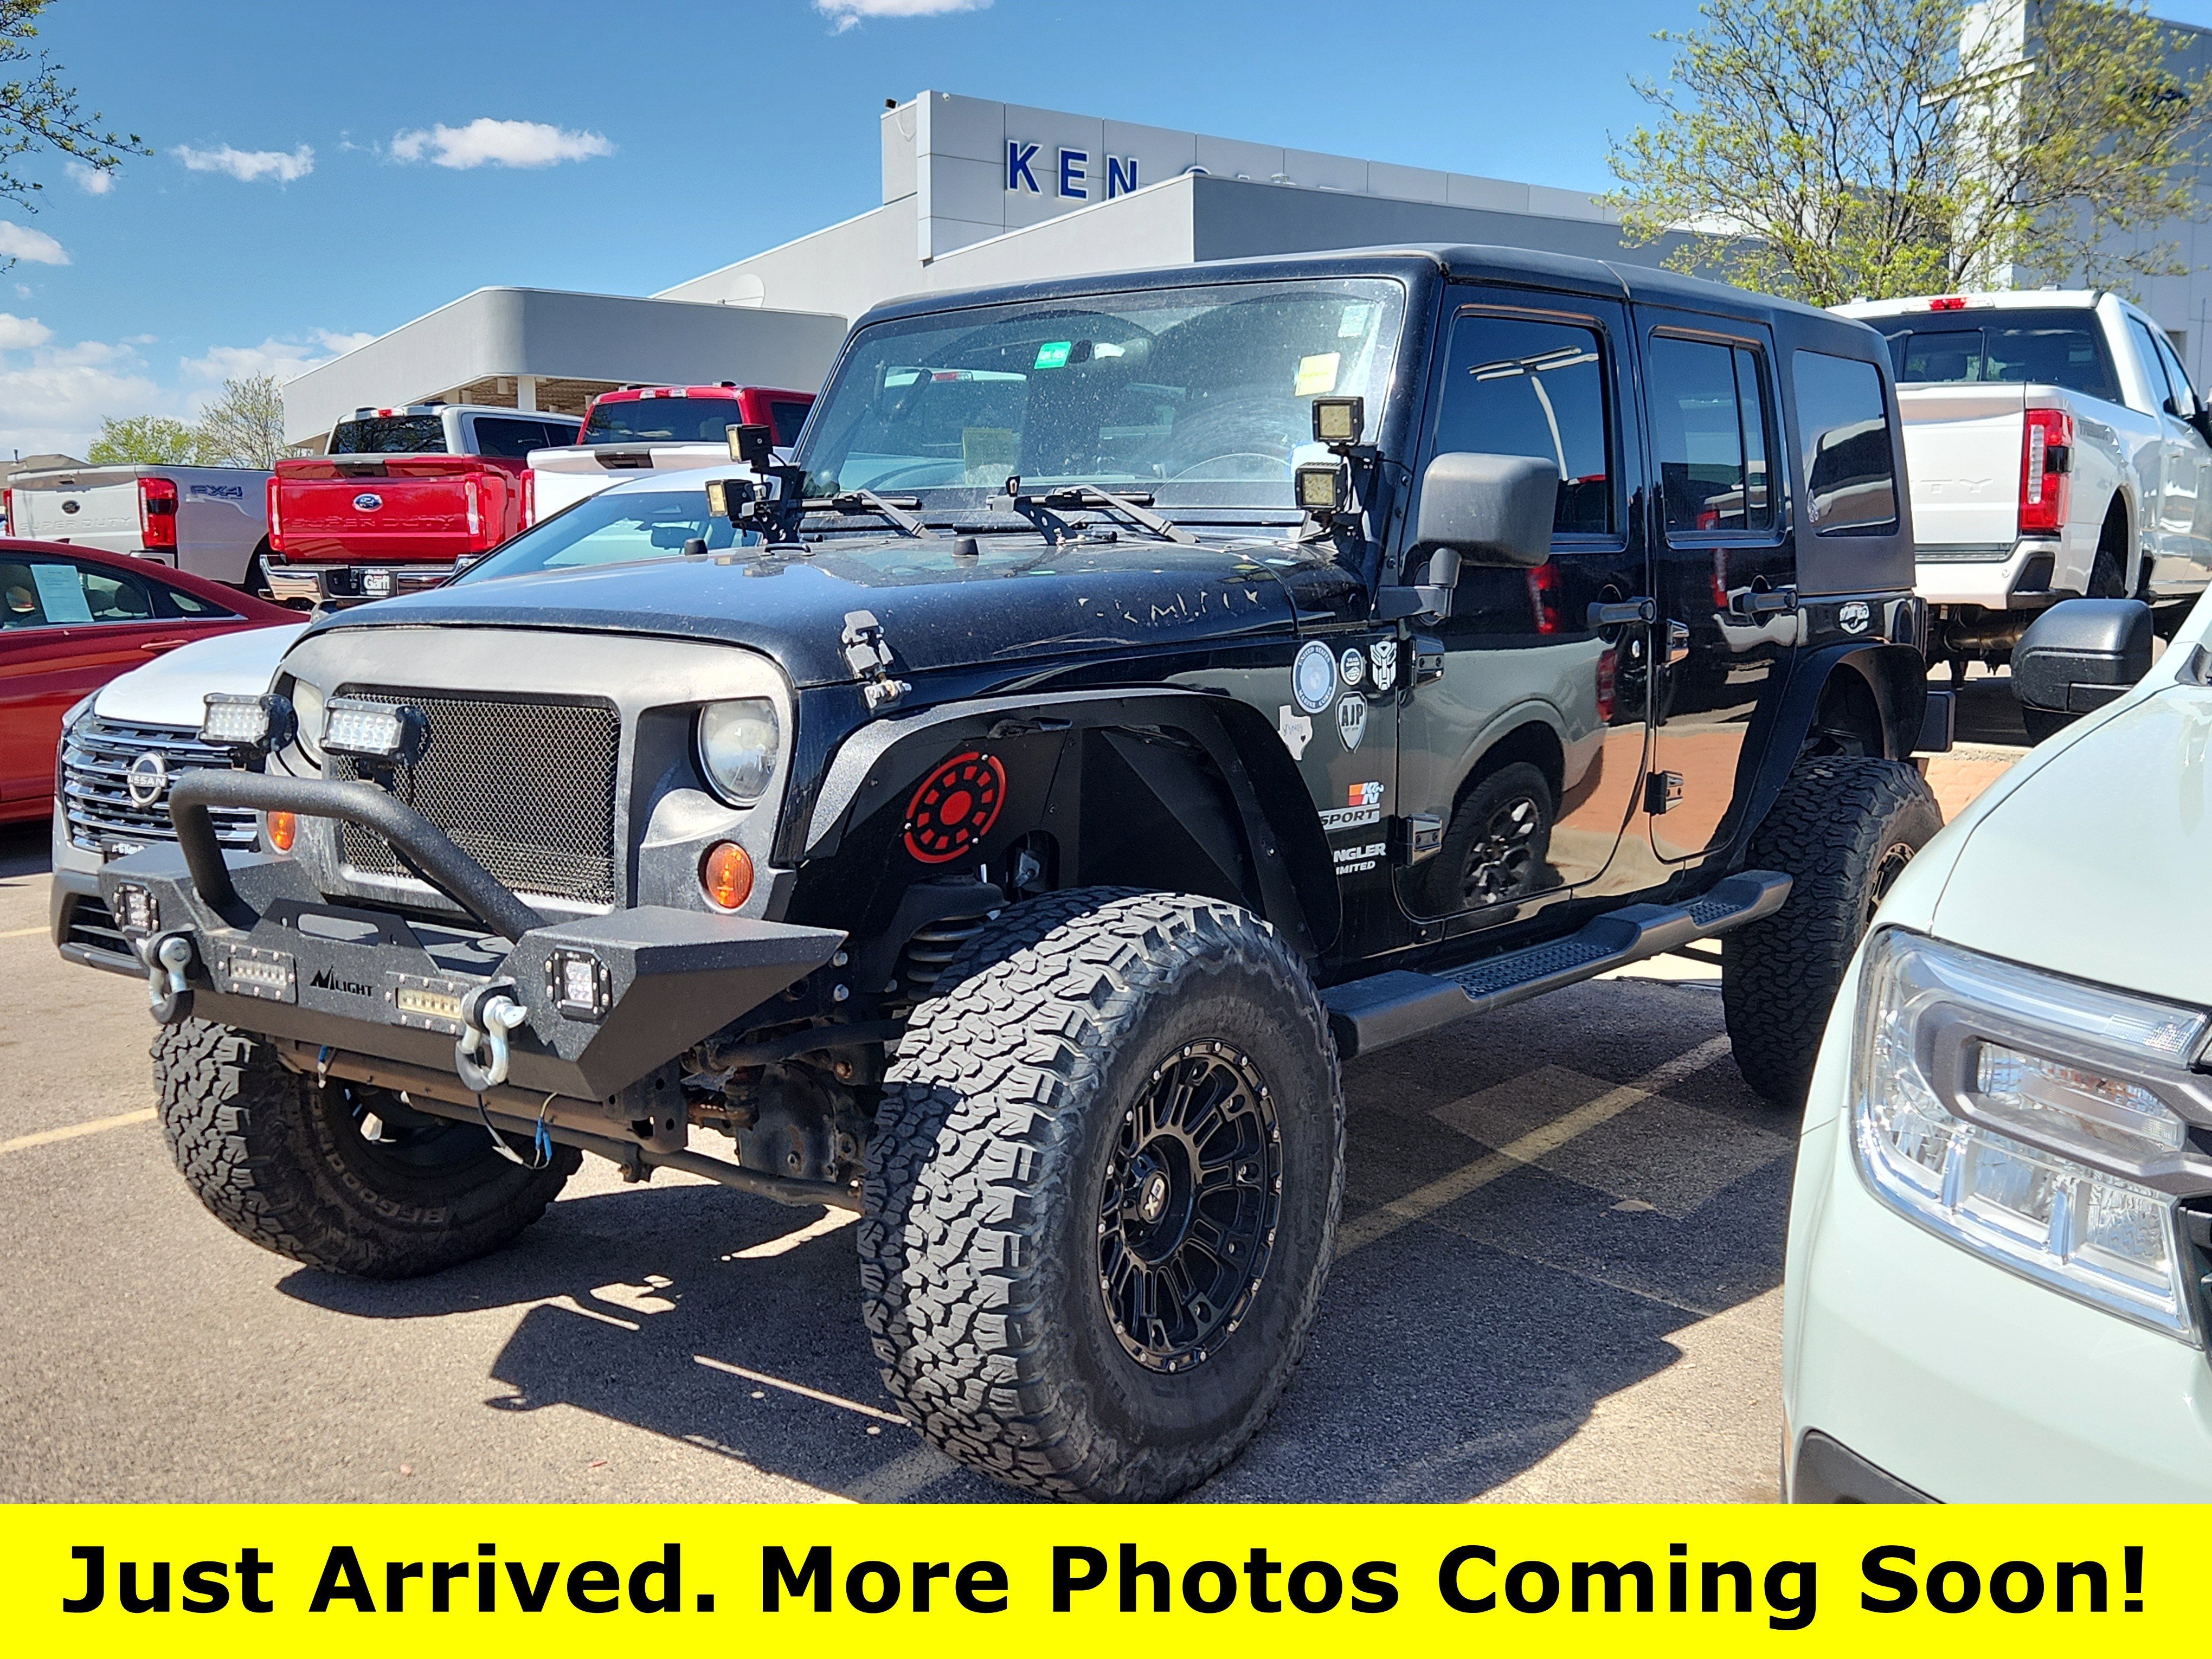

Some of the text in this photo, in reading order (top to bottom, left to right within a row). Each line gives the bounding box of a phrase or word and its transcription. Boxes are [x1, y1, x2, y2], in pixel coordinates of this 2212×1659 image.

[1007, 139, 1139, 201] KEN
[1911, 478, 1994, 494] TY
[20, 517, 132, 531] SUPER DUTY
[291, 516, 455, 528] SUPER DUTY
[1341, 704, 1363, 726] AJP
[1321, 808, 1380, 826] SPORT
[1333, 843, 1386, 863] NGLER
[1335, 860, 1376, 875] IMITED
